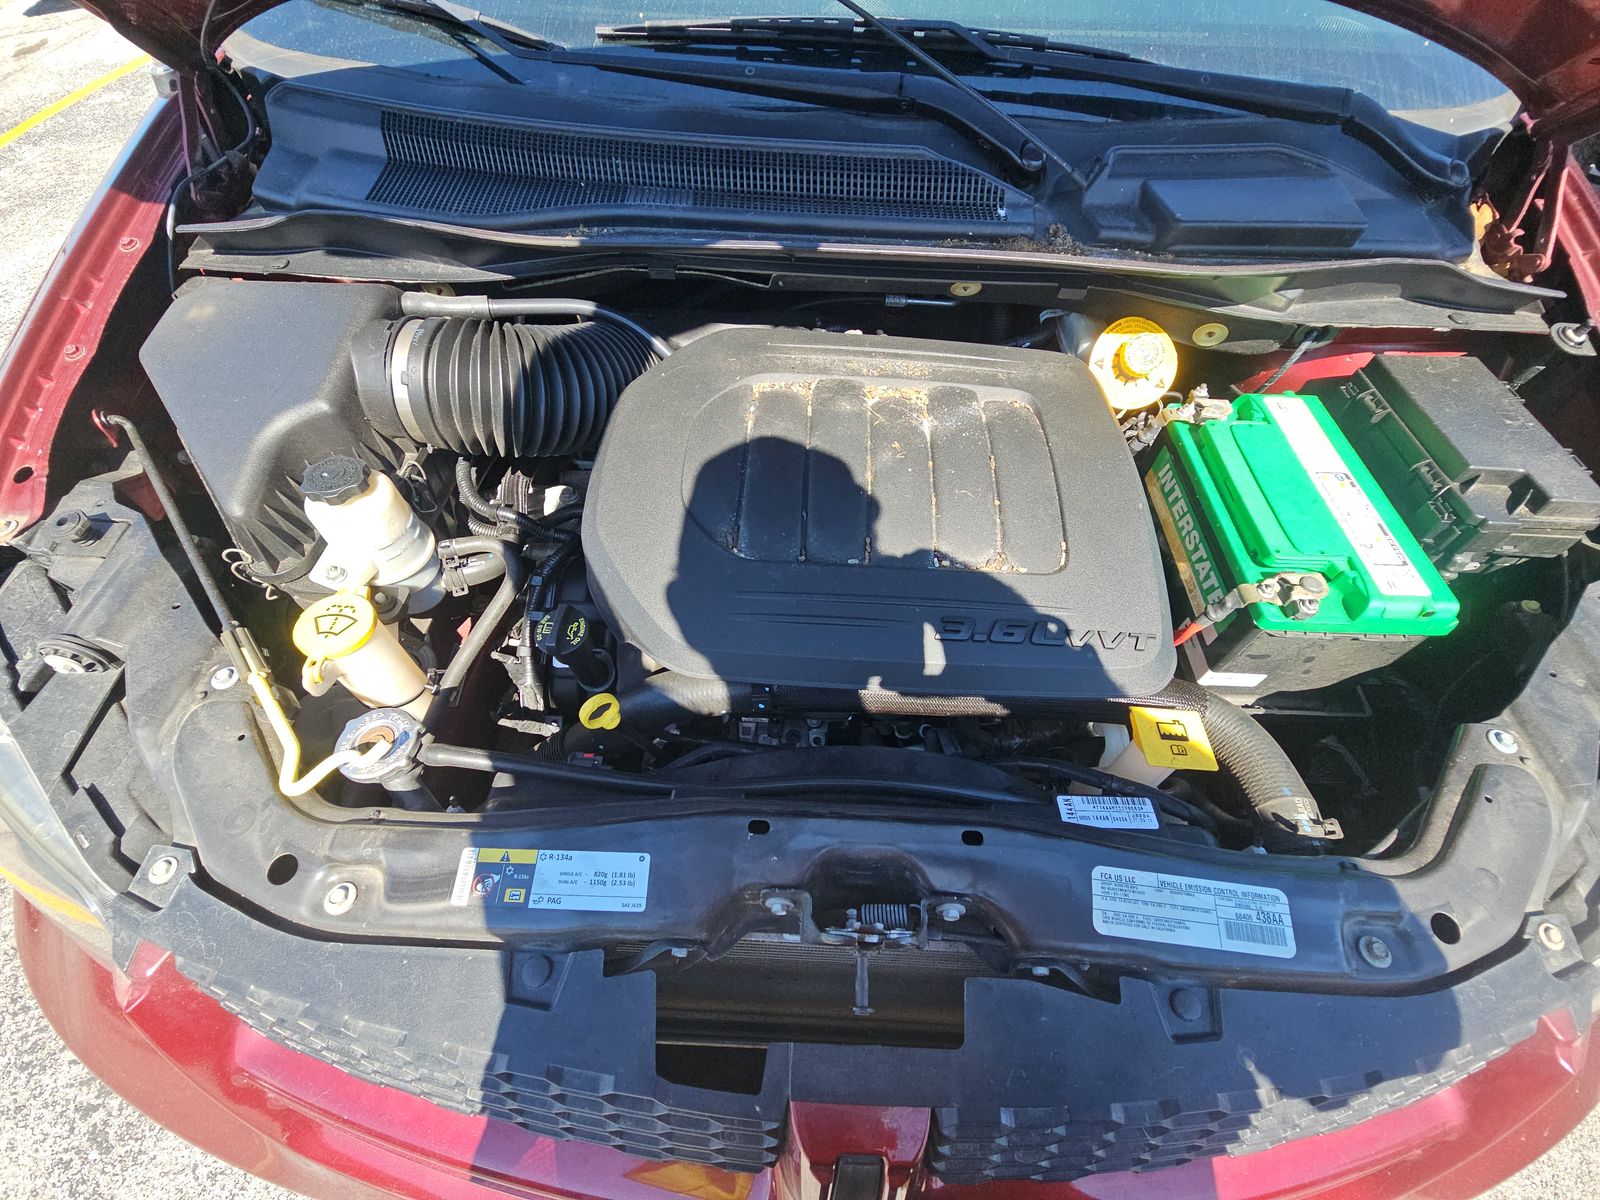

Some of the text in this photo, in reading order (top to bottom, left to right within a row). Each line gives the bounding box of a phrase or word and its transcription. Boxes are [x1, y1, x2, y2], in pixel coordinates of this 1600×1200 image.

[1158, 463, 1225, 605] INTERSTATE
[570, 636, 581, 646] OIL
[1066, 630, 1156, 651] VVT
[1100, 872, 1136, 884] FCA US LLC
[1159, 880, 1184, 890] VEHICLE
[1184, 882, 1212, 894] EMISSION
[1214, 886, 1240, 898] CONTROL
[1240, 890, 1282, 903] INFORMATION
[546, 897, 562, 905] PAG
[1256, 911, 1285, 926] 438AA
